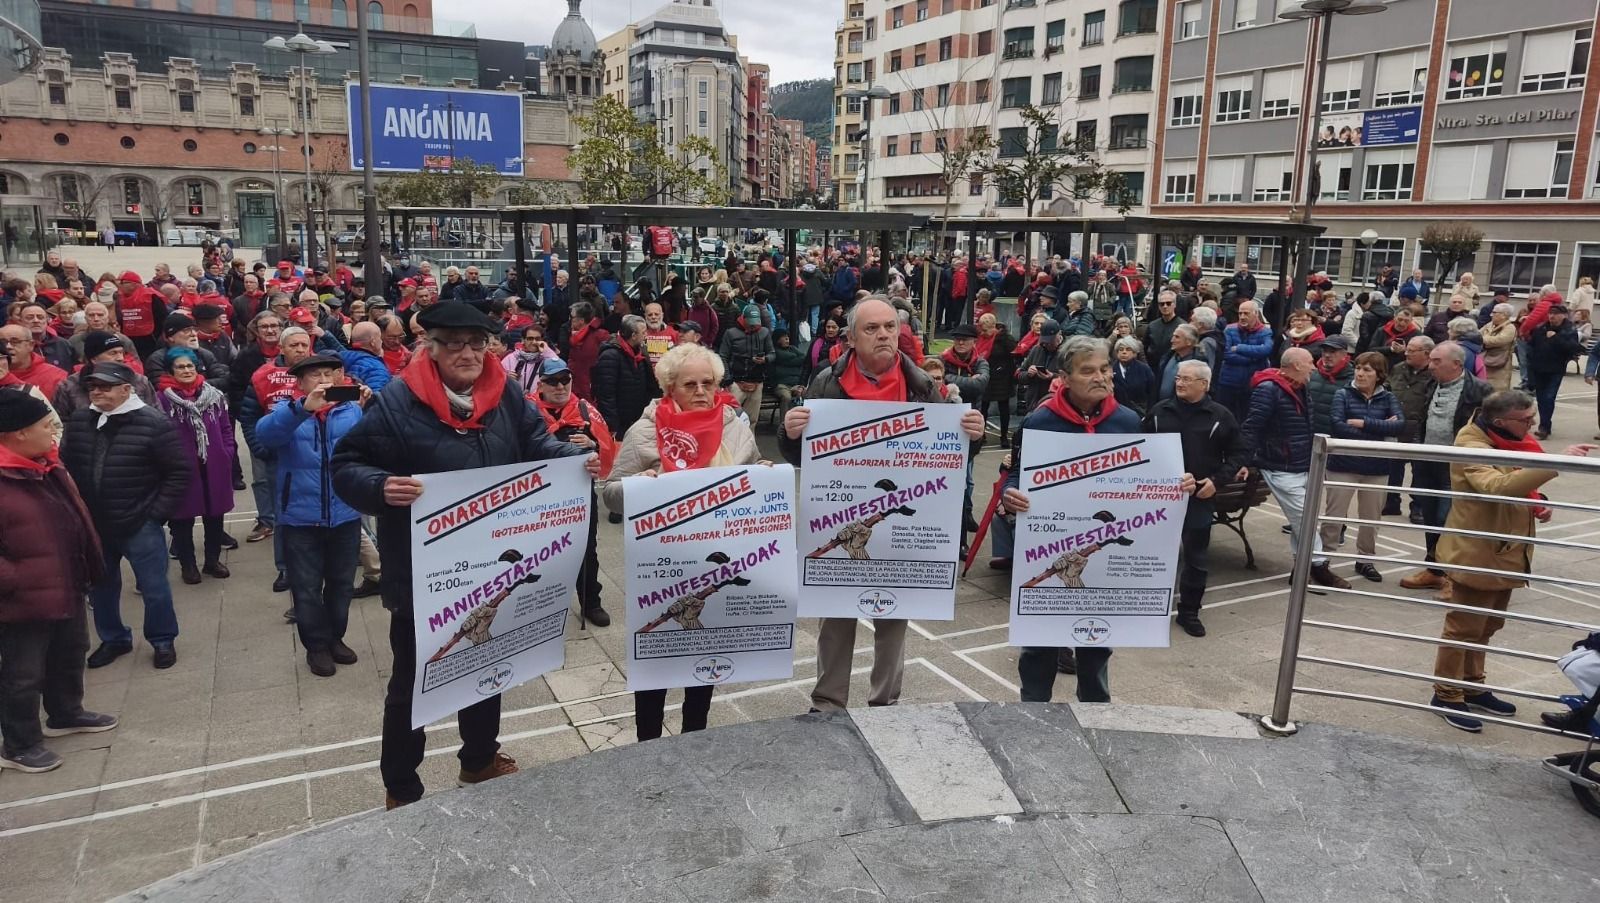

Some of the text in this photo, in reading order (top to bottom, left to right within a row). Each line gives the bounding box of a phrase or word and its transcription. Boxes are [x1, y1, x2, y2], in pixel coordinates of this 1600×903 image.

[1437, 117, 1472, 129] Ntra.
[1507, 111, 1532, 124] del
[1536, 108, 1577, 122] Pilar
[811, 414, 925, 456] INACEPTABLE
[937, 432, 958, 441] UPN
[886, 441, 899, 450] PP,
[902, 442, 922, 450] VOX
[930, 442, 962, 451] JUNTS
[833, 458, 890, 466] REVALORIZAR
[912, 460, 962, 469] PENSIONES!
[930, 452, 963, 461] CONTRA
[1032, 446, 1141, 485] ONARTEZINA
[829, 480, 842, 489] 29
[428, 472, 544, 535] ONARTEZINA
[764, 492, 785, 502] UPN
[826, 492, 853, 502] 12:00
[1146, 493, 1184, 502] KONTRA!
[531, 505, 546, 514] UPN
[562, 497, 584, 507] JUNTS
[540, 504, 586, 520] PENTSIOAK
[634, 476, 752, 535] INACEPTABLE
[714, 510, 728, 519] PP,
[732, 507, 751, 517] VOX
[759, 503, 788, 514] JUNTS
[810, 476, 948, 534] MANIFESTAZIOAK
[550, 512, 586, 527] KONTRA!
[759, 514, 792, 524] CONTRA
[1052, 512, 1066, 520] 29
[660, 522, 792, 544] REVALORIZAR LAS PENSIONES!
[1026, 508, 1167, 562] MANIFESTAZIOAK
[454, 561, 468, 573] 29
[470, 560, 498, 570] osteguna
[657, 558, 671, 566] 29
[638, 540, 780, 609] MANIFESTAZIOAK
[653, 569, 683, 578] 12:00
[428, 532, 572, 632] MANIFESTAZIOAK
